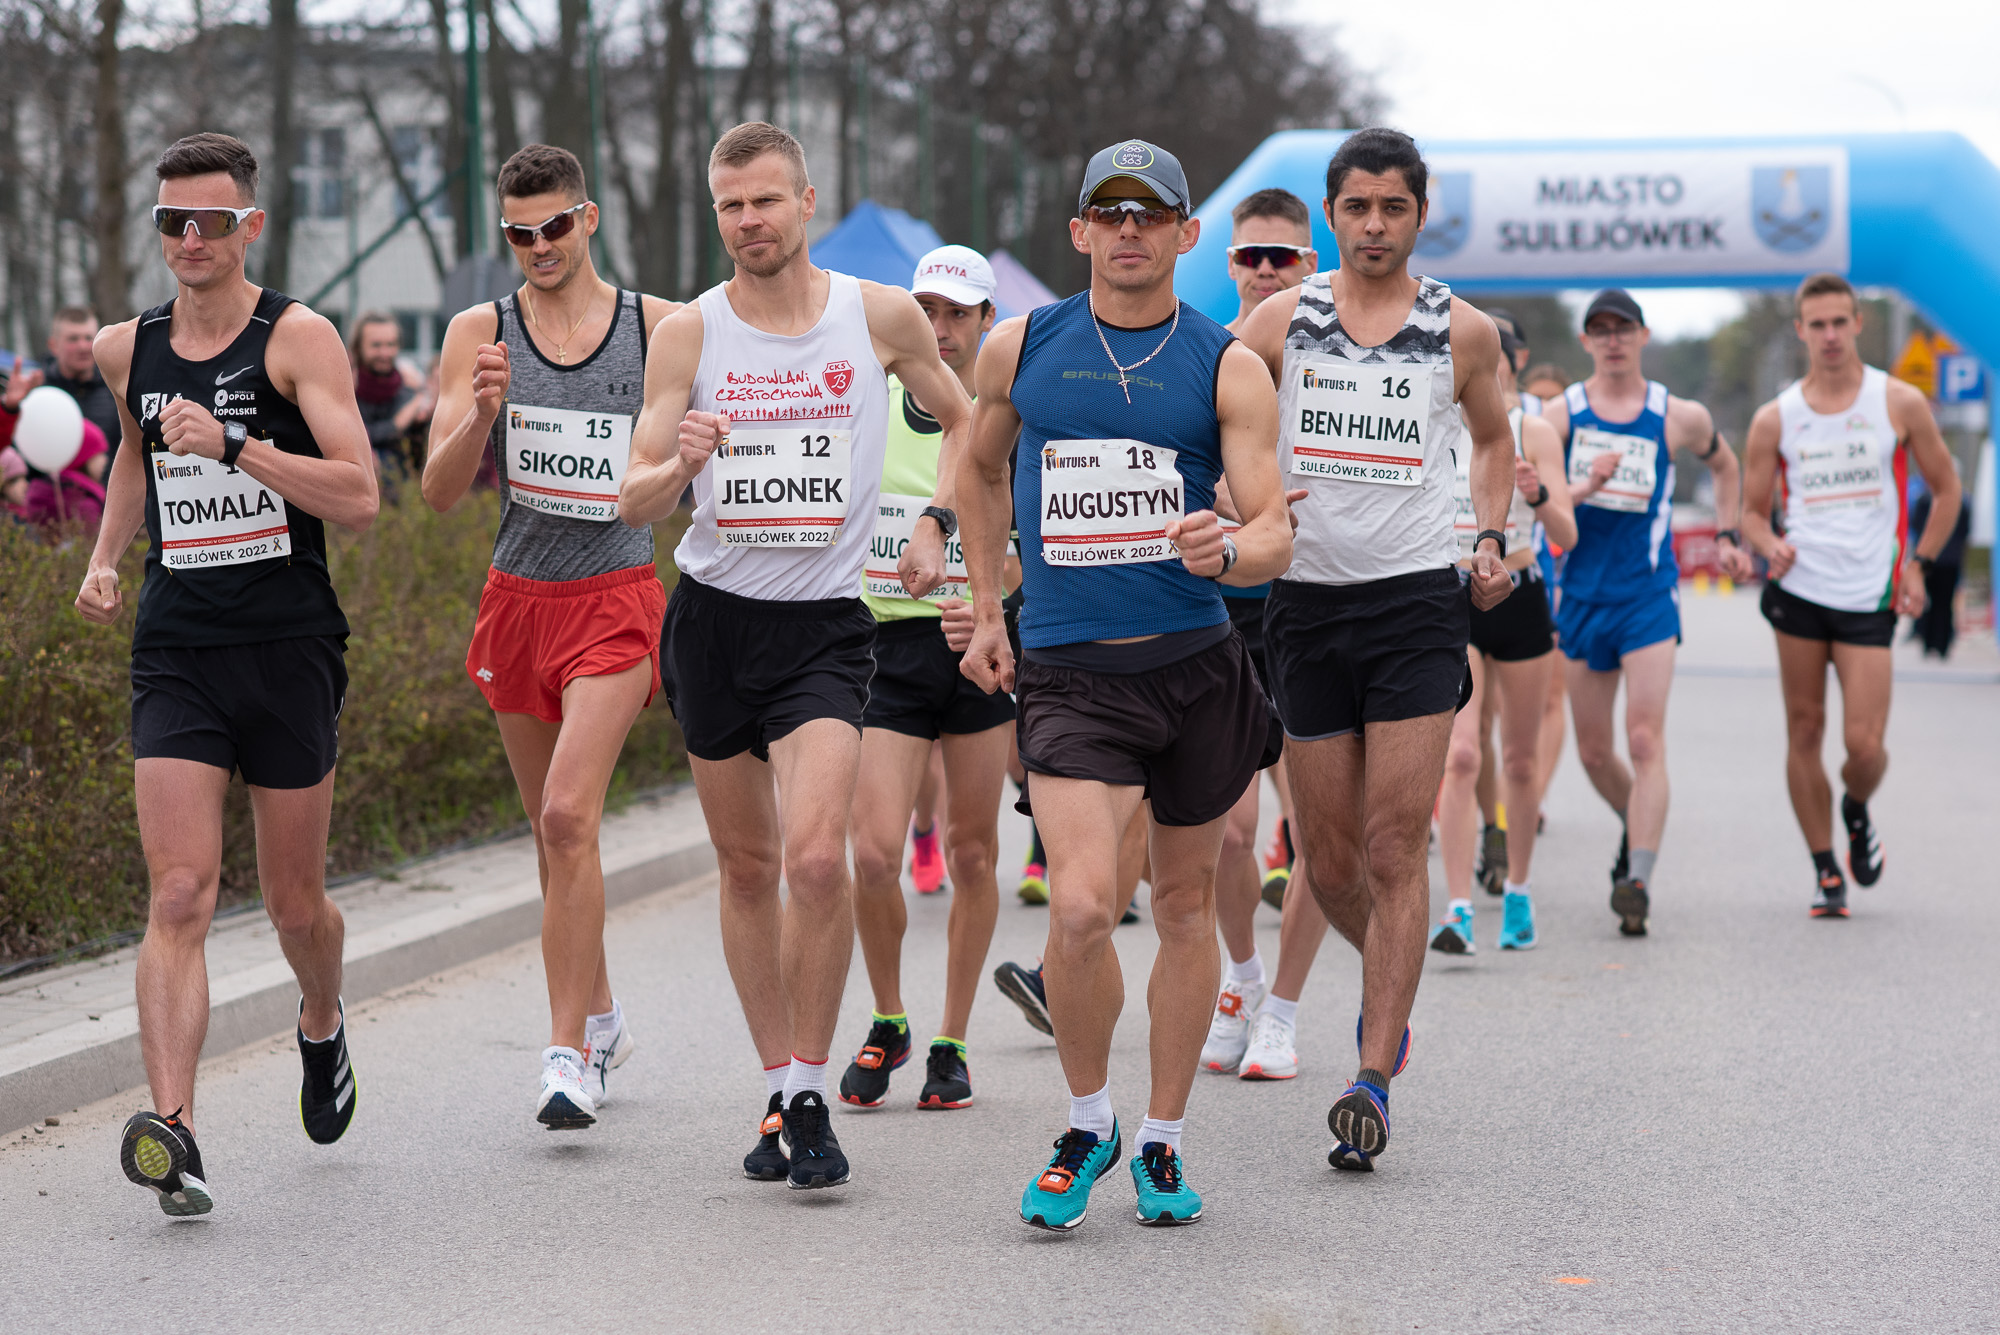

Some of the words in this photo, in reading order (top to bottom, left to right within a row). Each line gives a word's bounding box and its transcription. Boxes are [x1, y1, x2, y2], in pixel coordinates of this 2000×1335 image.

[1537, 175, 1685, 206] MIASTO
[1497, 211, 1727, 253] SULEJÓWEK
[920, 264, 967, 278] LATVIA
[829, 363, 846, 371] CKS
[1062, 371, 1164, 390] BRUBECK
[1382, 376, 1411, 399] 16
[228, 393, 255, 401] OPOLE
[586, 418, 613, 439] 15
[1301, 409, 1343, 437] BEN
[1347, 414, 1421, 445] HLIMA
[800, 435, 831, 458] 12
[1126, 446, 1157, 470] 18
[519, 449, 614, 481] SIKORA
[1300, 461, 1367, 477] SULEJÓWEK
[1371, 469, 1400, 480] 2022
[721, 477, 843, 505] JELONEK
[164, 489, 277, 526] TOMALA
[515, 493, 574, 513] SULEJÓWEK
[577, 505, 604, 516] 2022
[1046, 488, 1180, 520] AUGUSTYN
[726, 530, 796, 543] SULEJÓWEK
[800, 532, 829, 543] 2022
[170, 550, 235, 565] SULEJÓWEK
[238, 544, 268, 559] 2022
[1050, 547, 1126, 561] SULEJÓWEK
[1130, 545, 1162, 559] 2022
